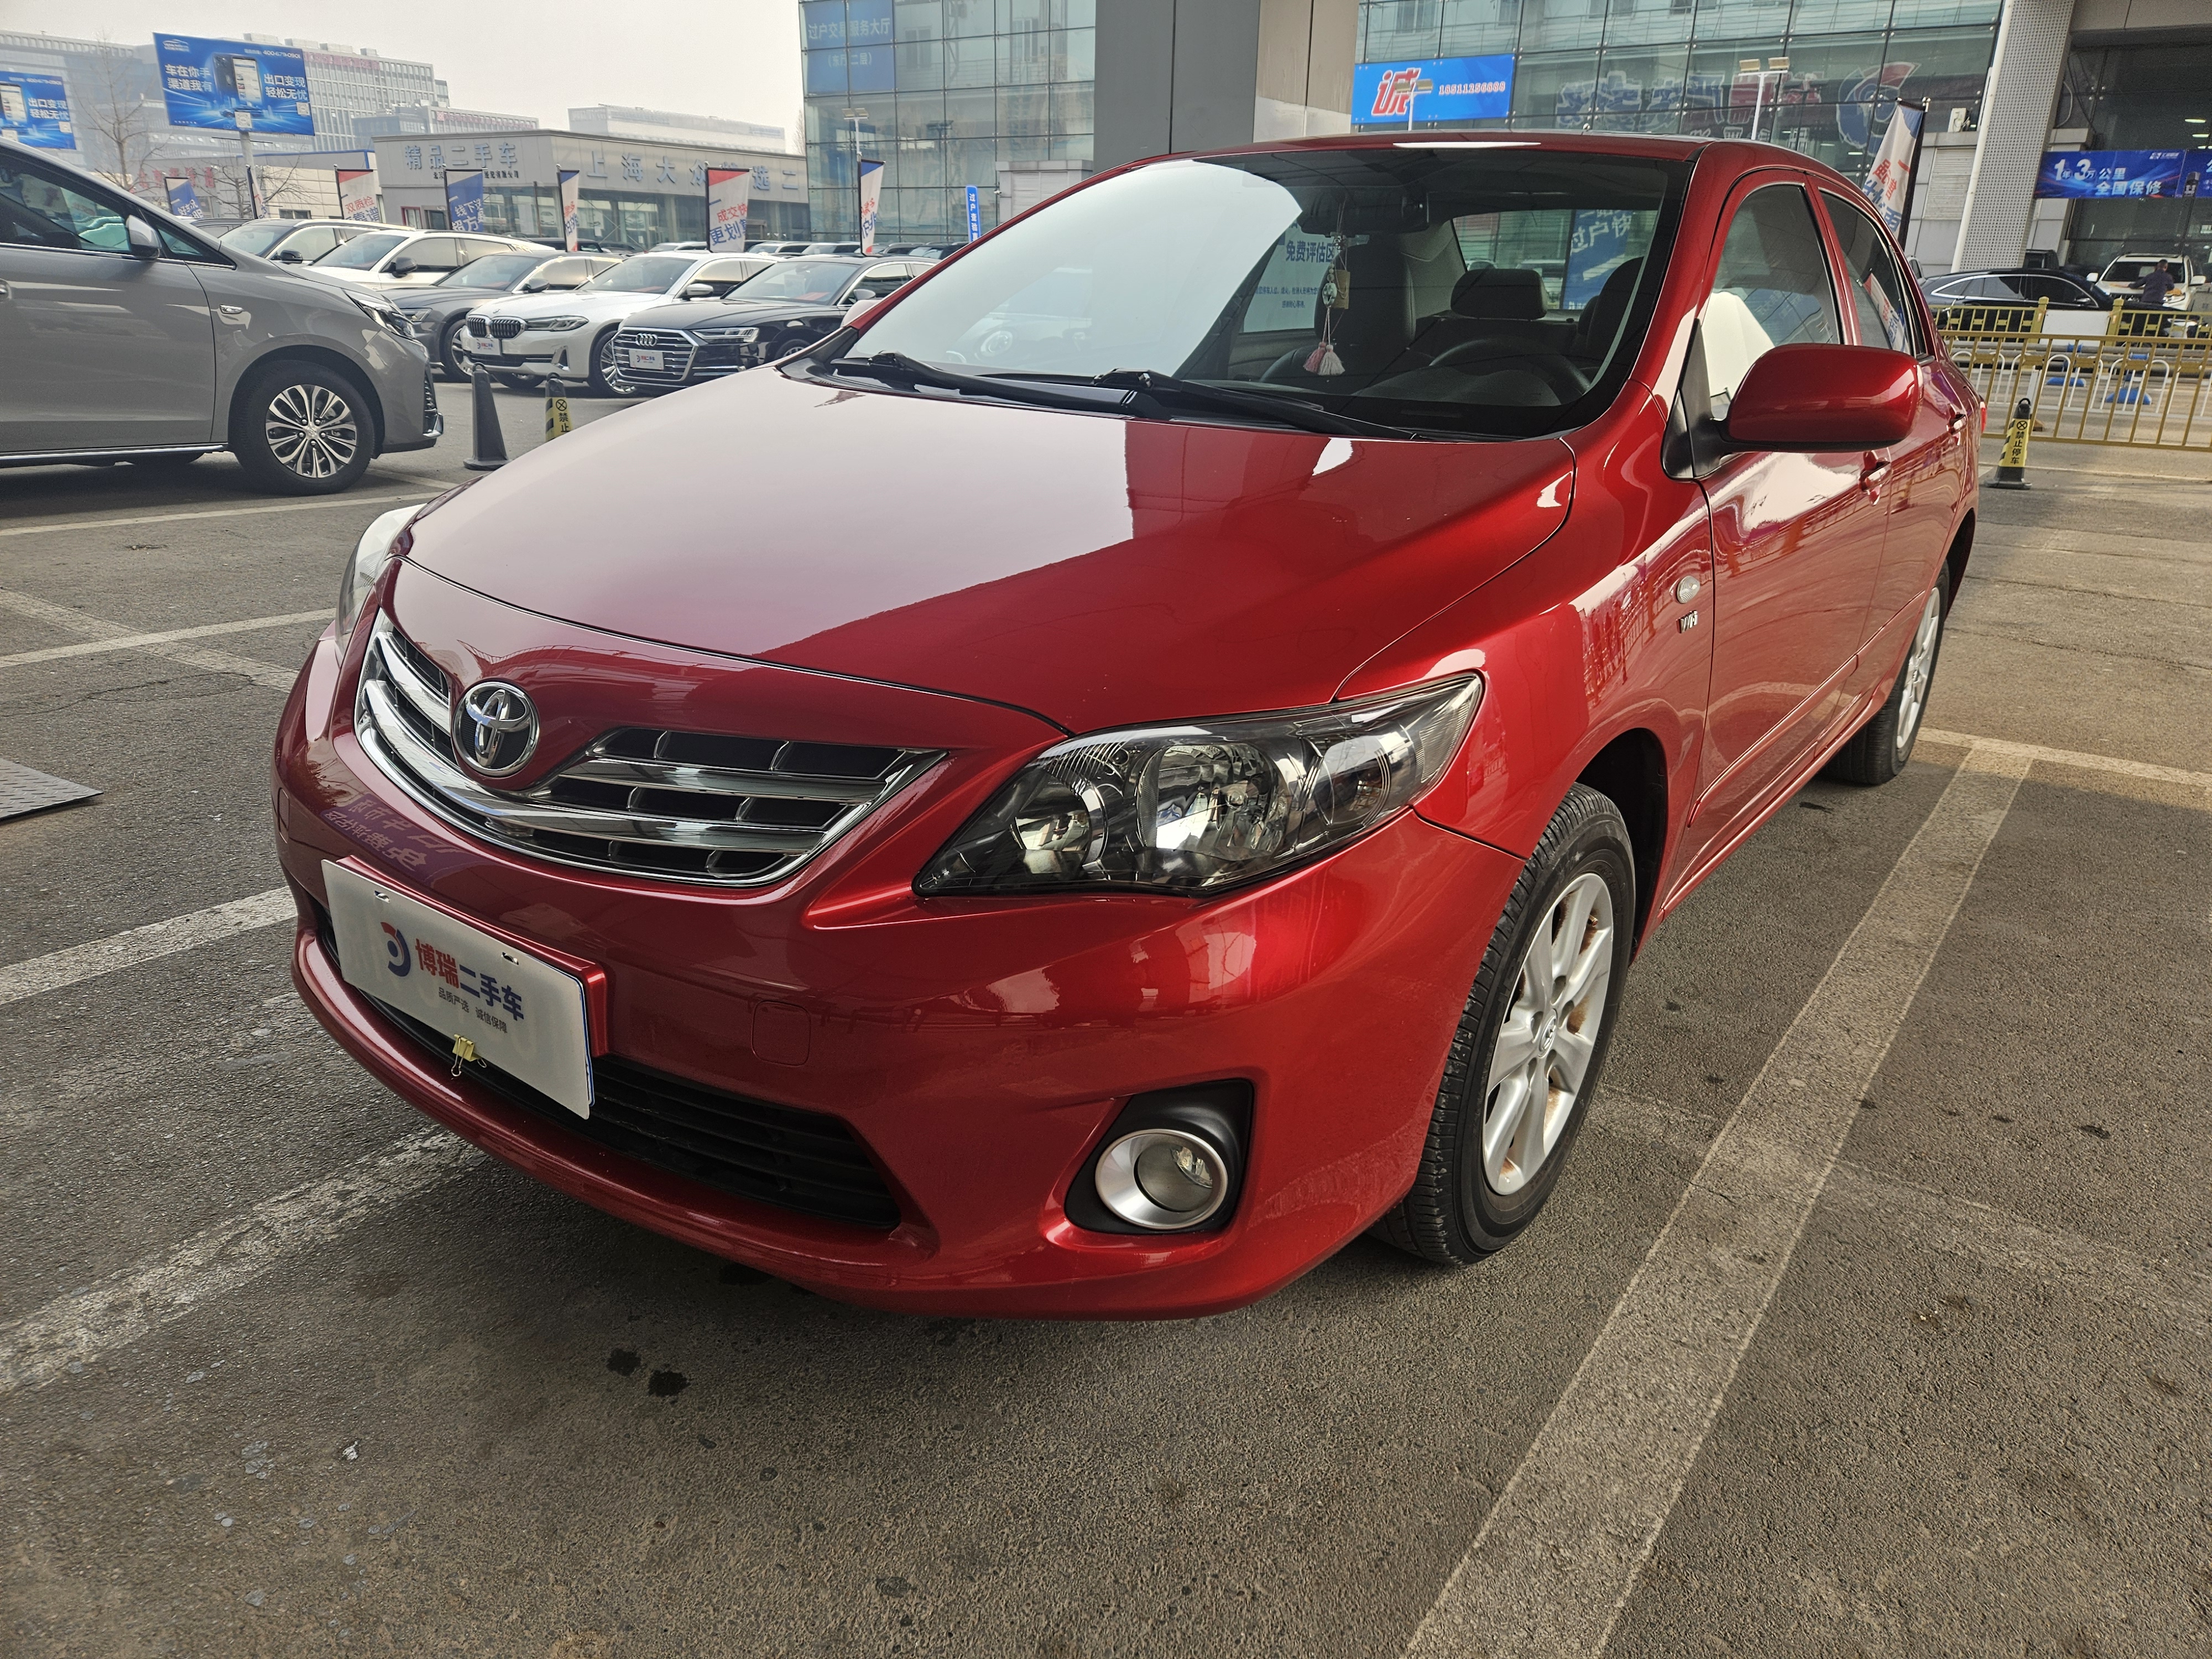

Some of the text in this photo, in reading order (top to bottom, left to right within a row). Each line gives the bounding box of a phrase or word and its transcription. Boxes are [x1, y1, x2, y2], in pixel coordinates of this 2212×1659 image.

[808, 18, 890, 40] 过户交易服务大厅
[165, 64, 211, 79] 车在你手
[168, 77, 212, 92] 渠道我有
[264, 74, 306, 88] 出口变现
[1439, 81, 1506, 95] 18511256888
[265, 86, 308, 101] 轻松无忧
[28, 97, 67, 109] 出口变现
[29, 108, 70, 121] 轻松无忧
[404, 142, 517, 169] 精品二手车
[587, 150, 799, 191] 上海大众选二
[2095, 180, 2162, 196] 全国保修
[178, 200, 199, 215] 好车况
[345, 196, 374, 214] 双质检
[345, 207, 379, 222] 靠谱
[1286, 240, 1334, 263] 免费评估区
[559, 413, 570, 432] 禁止
[2011, 431, 2025, 465] 禁止停车
[415, 938, 524, 1021] 博瑞二手车
[439, 987, 508, 1034] 品质严选 诚信保障
